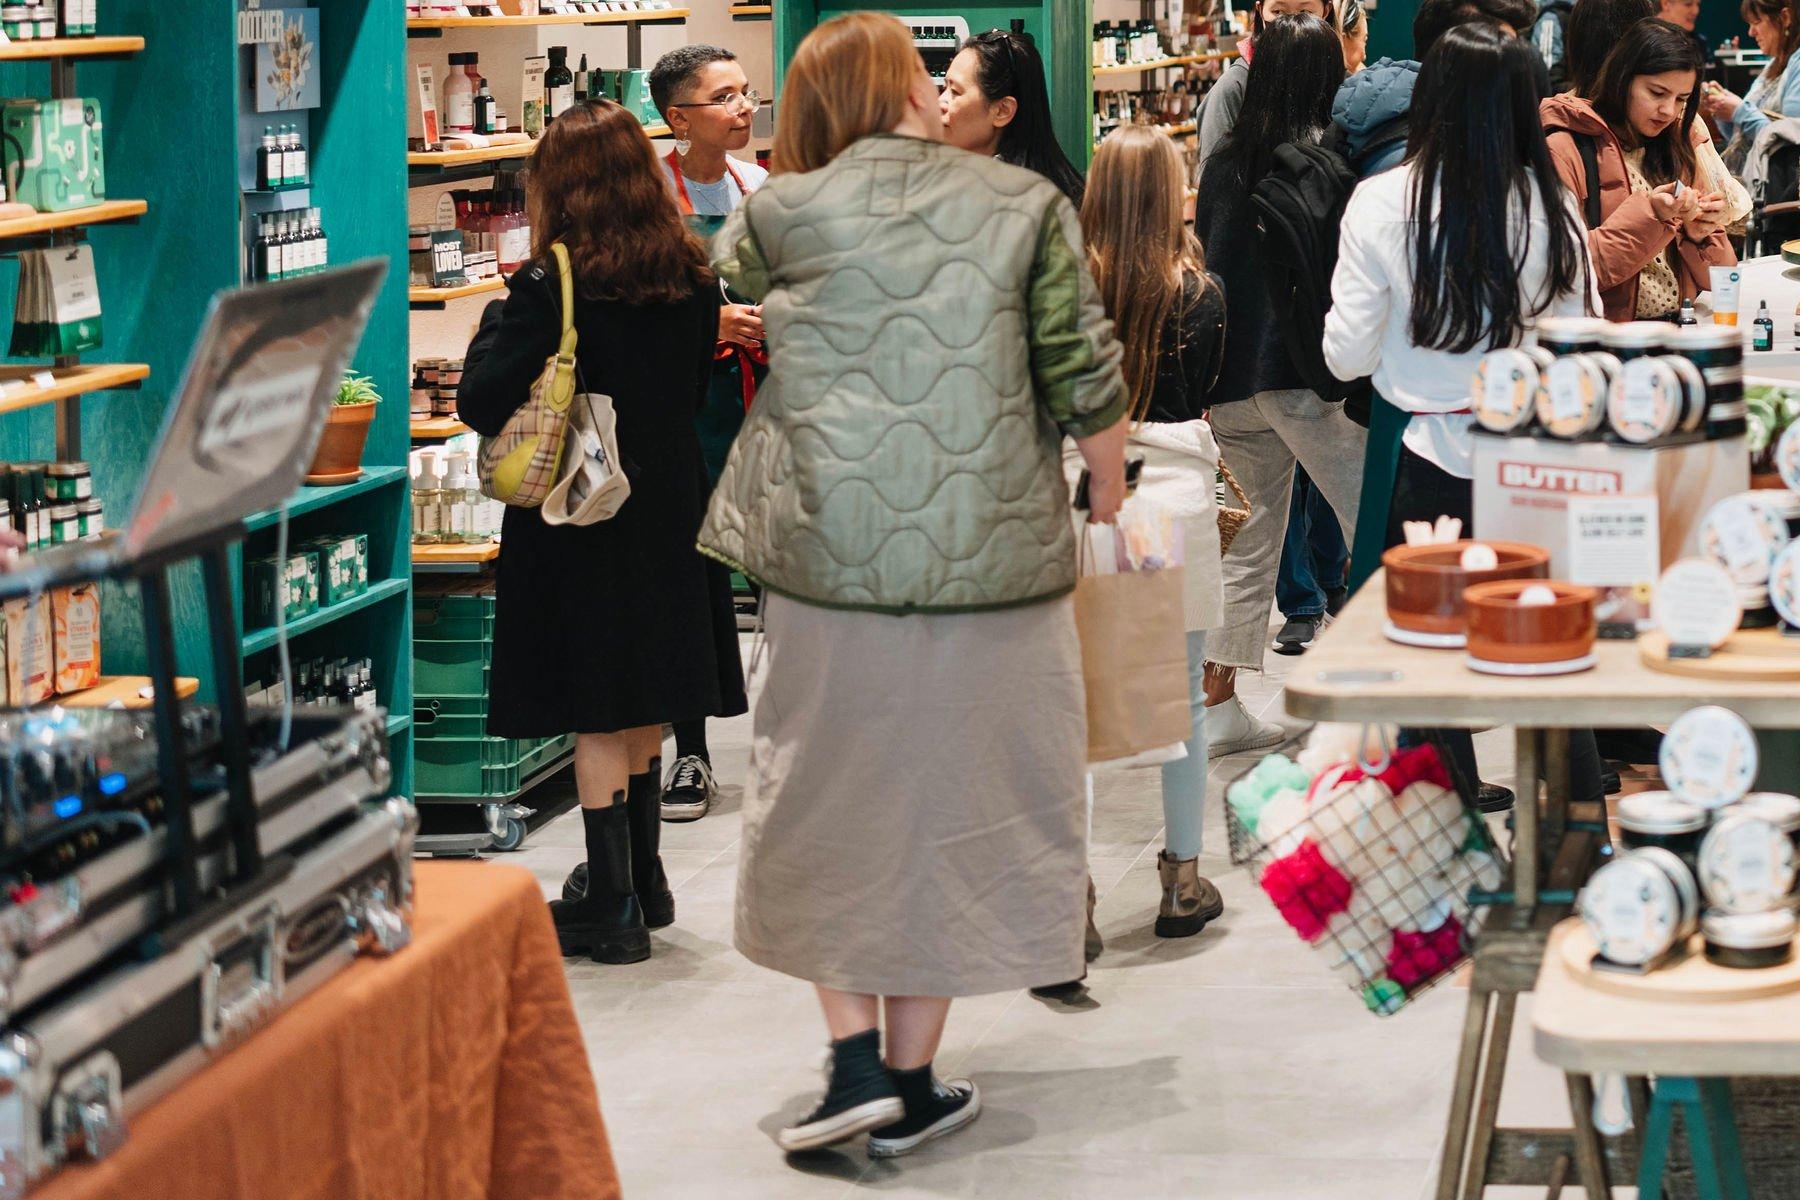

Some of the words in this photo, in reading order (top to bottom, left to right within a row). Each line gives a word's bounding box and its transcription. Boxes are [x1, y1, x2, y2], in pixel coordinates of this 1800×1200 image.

[433, 241, 461, 253] MOST
[435, 250, 463, 273] LOVED
[1502, 463, 1618, 493] BUTTER
